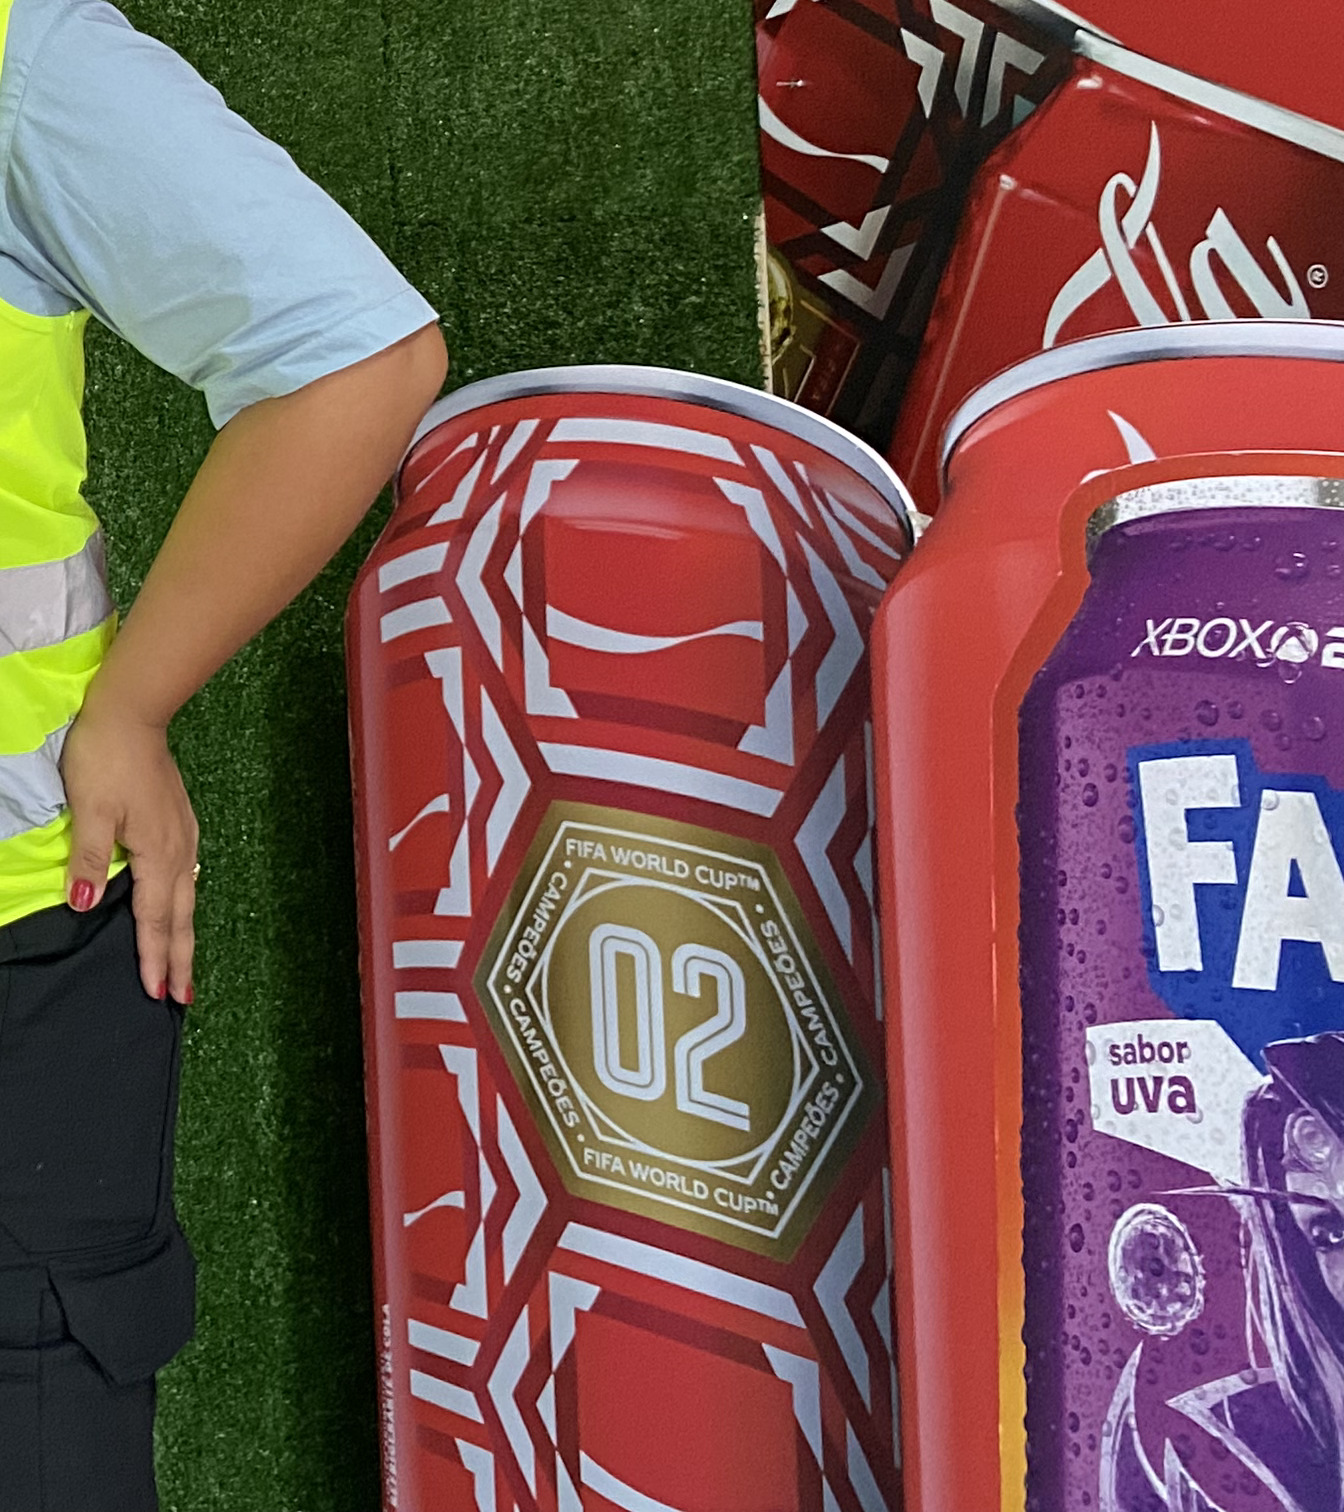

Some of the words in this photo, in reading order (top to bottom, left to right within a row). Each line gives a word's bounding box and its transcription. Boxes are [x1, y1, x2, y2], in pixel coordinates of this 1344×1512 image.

[1130, 617, 1275, 659] XBOX
[565, 838, 607, 862] FIFA
[611, 845, 690, 879] WORLD
[1138, 754, 1344, 991] FA
[506, 871, 568, 984] CAMPEÕES
[589, 923, 751, 1132] 02
[762, 919, 838, 1067] CAMPEÕES
[510, 998, 580, 1129] CAMPEÕES
[1109, 1034, 1188, 1067] sabor
[1110, 1072, 1197, 1115] uva
[583, 1146, 626, 1176] FIFA
[629, 1160, 710, 1200] WORLD
[771, 1082, 840, 1189] CAMPEÕES
